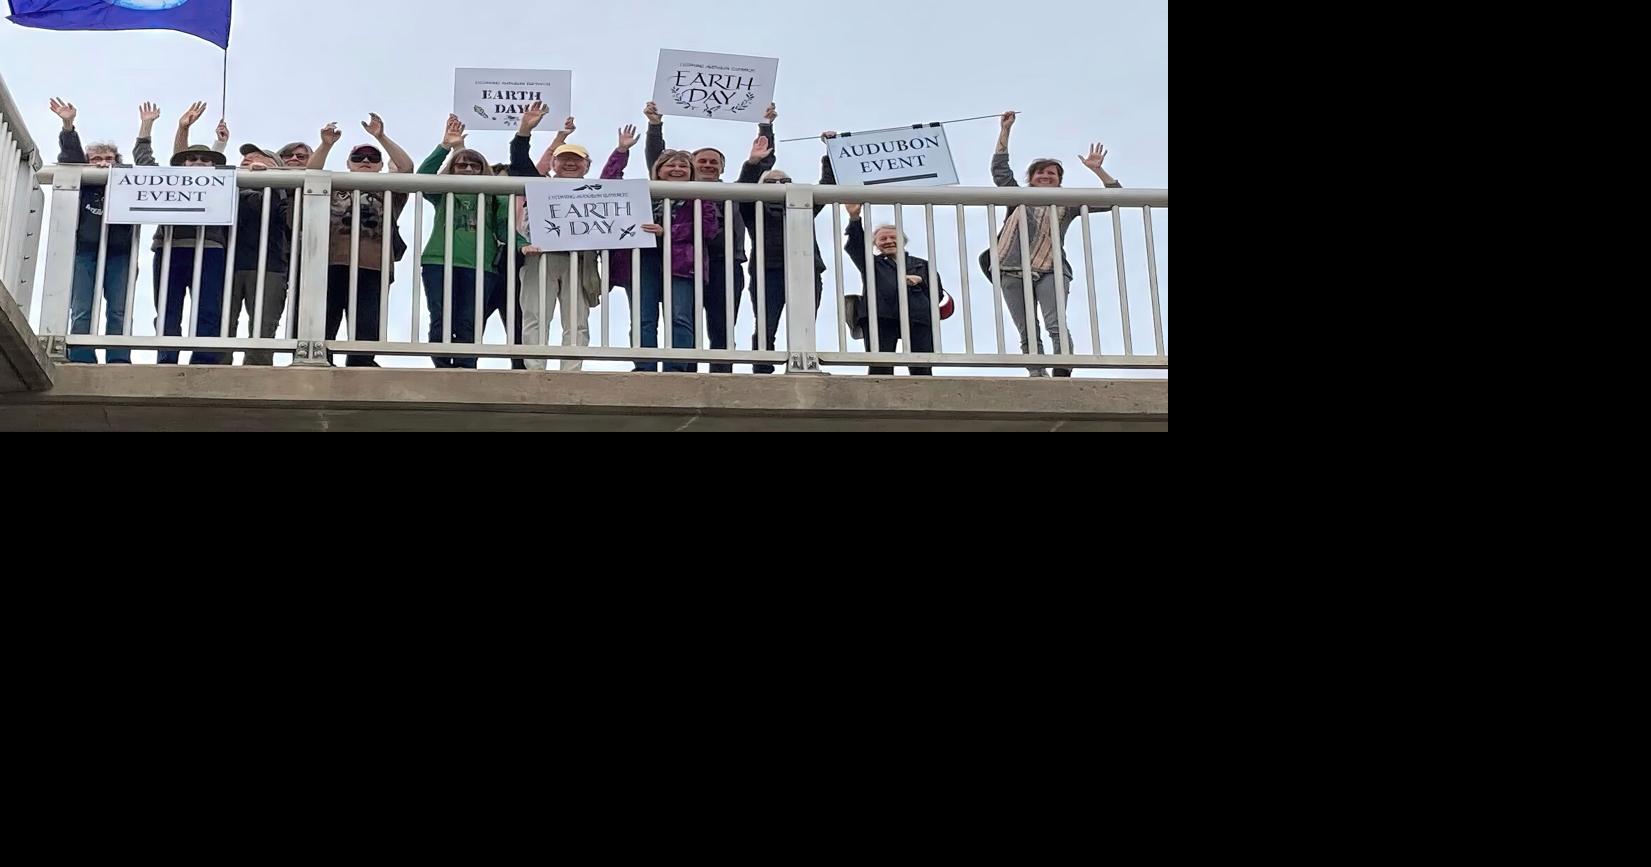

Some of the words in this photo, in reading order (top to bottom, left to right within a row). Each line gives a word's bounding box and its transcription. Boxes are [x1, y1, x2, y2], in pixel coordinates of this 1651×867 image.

[669, 71, 760, 90] EARTH
[482, 90, 542, 100] EARTH
[681, 88, 736, 105] DAY
[495, 104, 530, 114] DAY
[839, 135, 940, 159] AUDUBON
[860, 154, 926, 173] EVENT
[119, 174, 226, 187] AUDUBON
[137, 190, 207, 202] EVENT
[549, 201, 632, 219] EARTH
[569, 219, 615, 236] DAY
